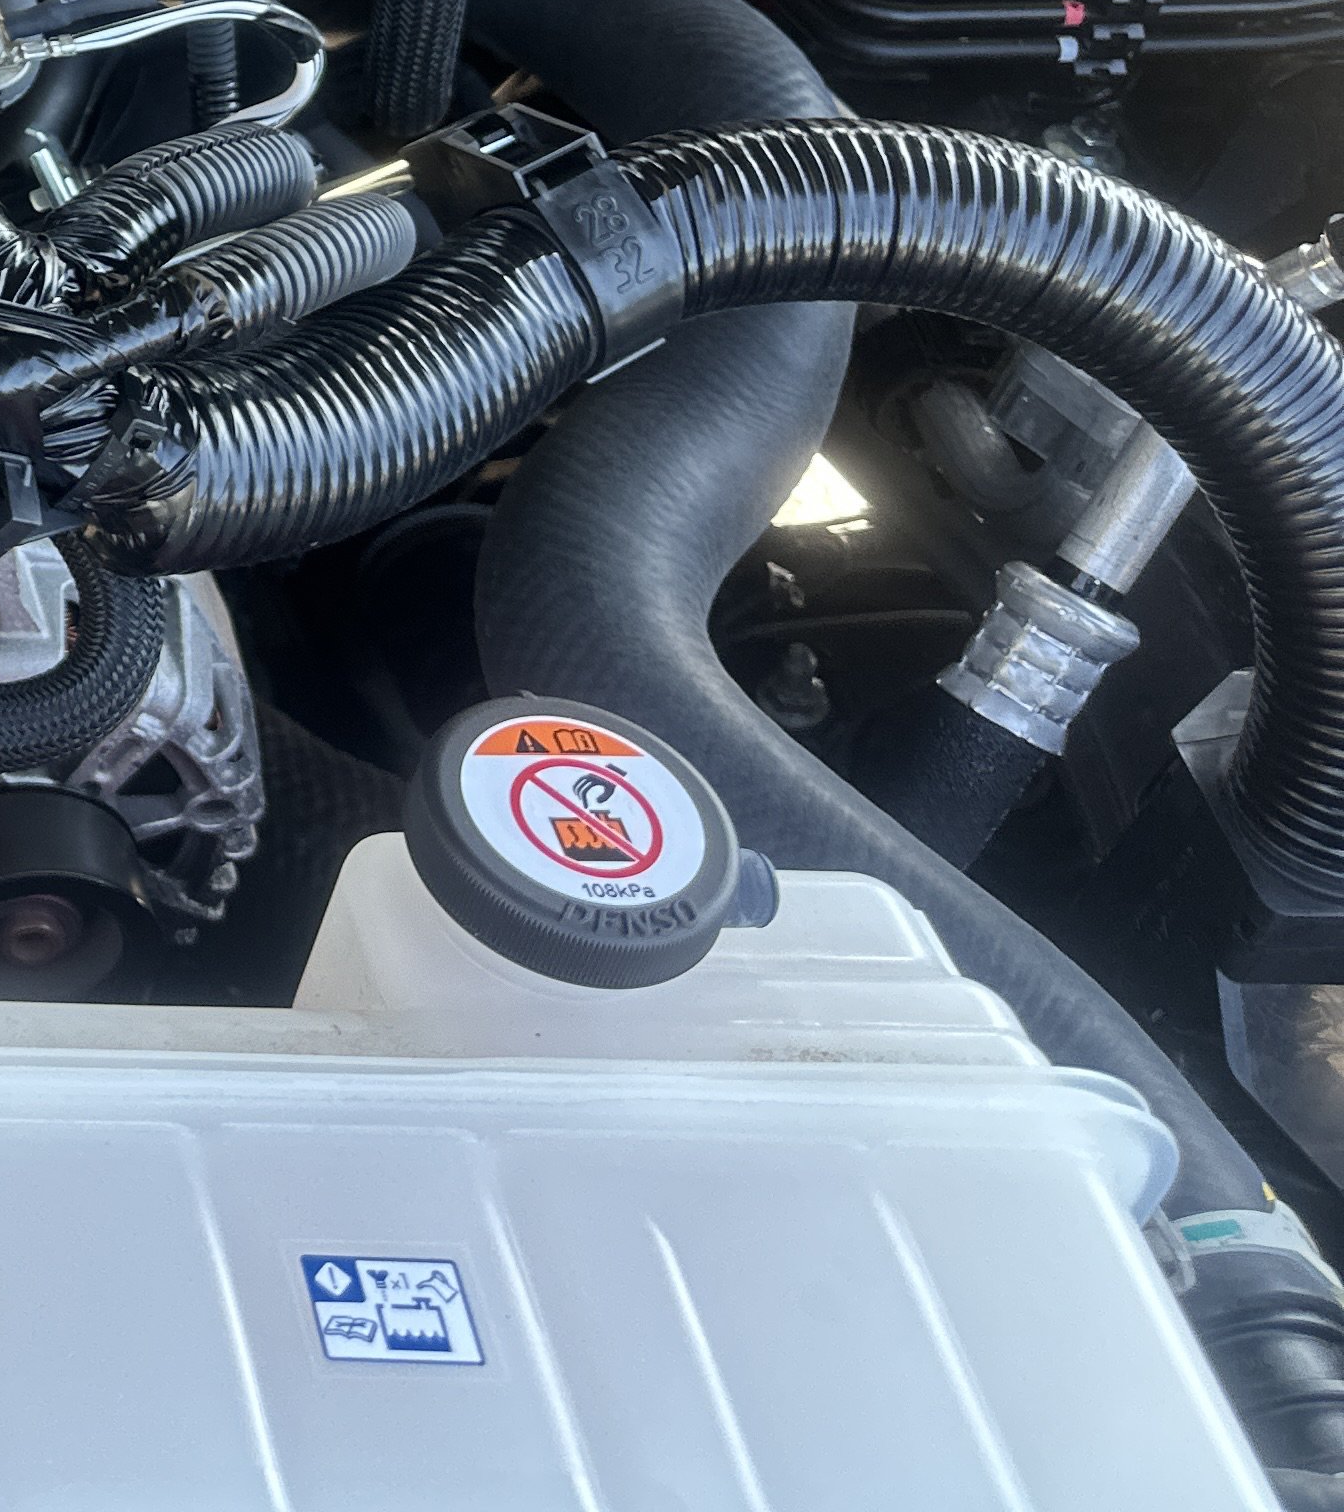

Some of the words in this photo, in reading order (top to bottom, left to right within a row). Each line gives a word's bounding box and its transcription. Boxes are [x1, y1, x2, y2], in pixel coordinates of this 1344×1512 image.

[573, 194, 630, 249] 28
[596, 235, 657, 295] 32
[581, 882, 656, 899] 108kPa
[560, 897, 698, 937] DENSO
